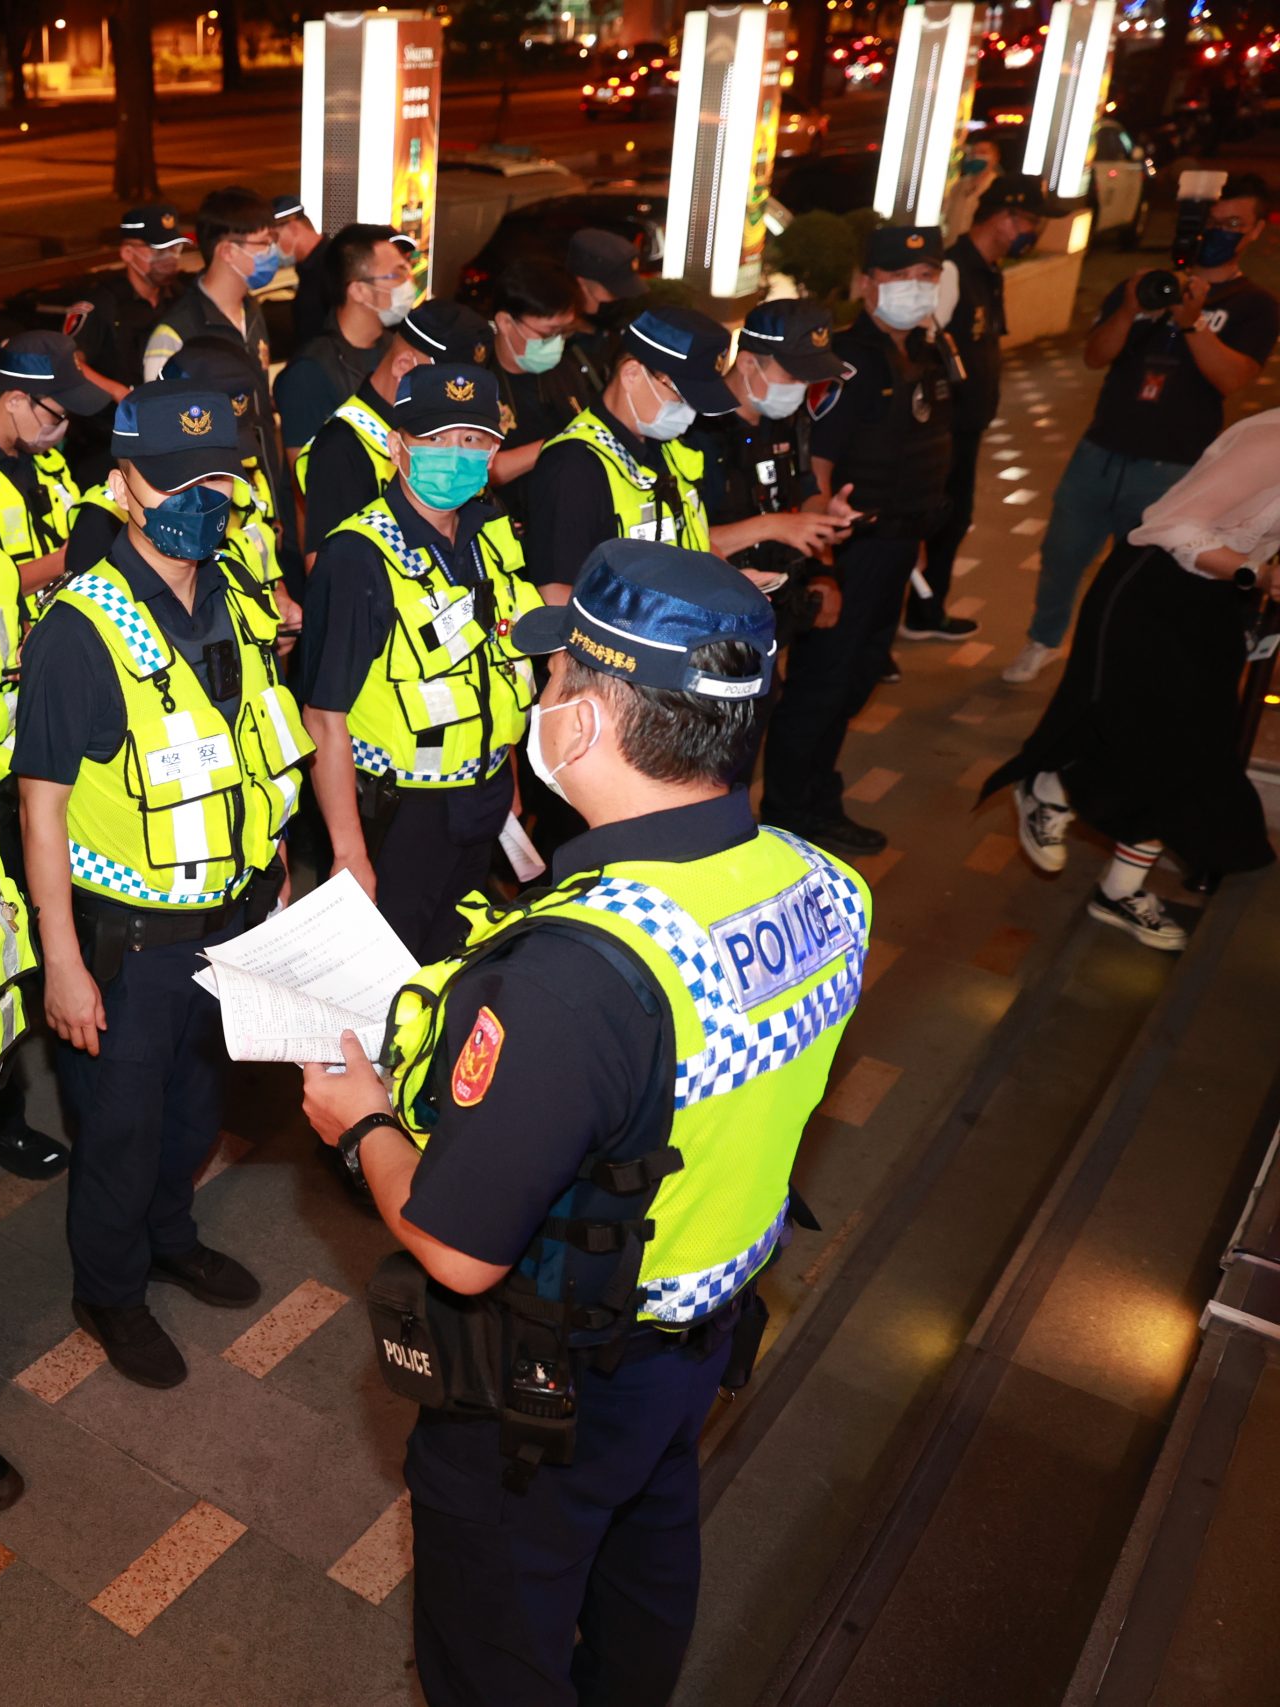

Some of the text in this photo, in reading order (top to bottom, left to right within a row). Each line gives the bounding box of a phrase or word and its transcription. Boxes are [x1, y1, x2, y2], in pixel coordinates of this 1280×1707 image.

[161, 744, 219, 776] 警察
[725, 884, 841, 991] POLICE
[383, 1338, 432, 1378] POLICE
